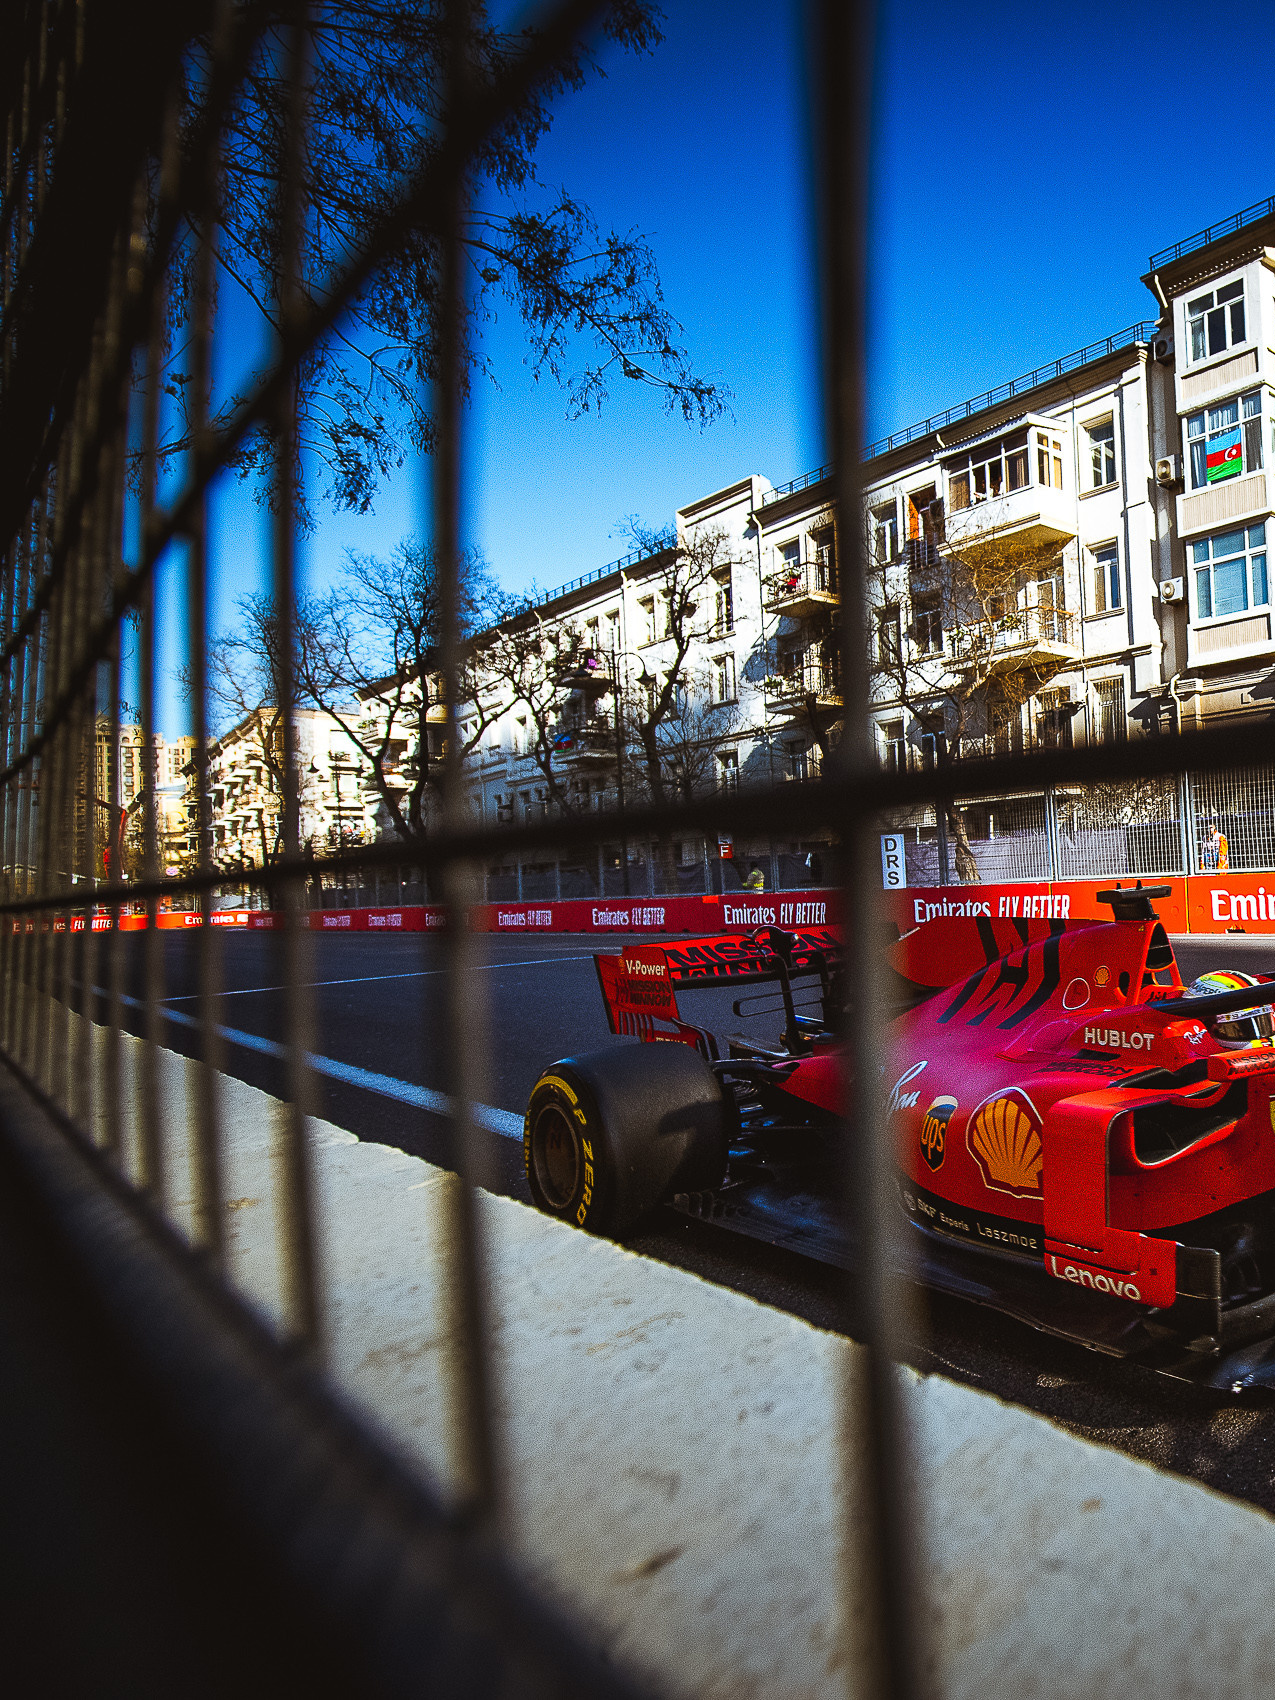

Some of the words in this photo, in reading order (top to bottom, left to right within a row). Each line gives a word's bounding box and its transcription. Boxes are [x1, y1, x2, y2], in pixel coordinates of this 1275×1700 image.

[720, 845, 729, 857] F
[884, 837, 900, 886] DRS
[184, 915, 235, 925] Emrates
[498, 911, 526, 926] Emirates
[592, 908, 630, 926] Emirates
[723, 903, 776, 925] Emirates
[779, 903, 793, 925] FLY
[795, 902, 827, 925] BETTER
[913, 897, 991, 924] Emirates
[91, 919, 114, 930] BETTE
[625, 959, 667, 977] V-Power
[1084, 1027, 1155, 1051] HUBLOT
[920, 1114, 947, 1160] ups
[576, 1137, 594, 1225] ZERO
[917, 1198, 937, 1219] SKF
[1050, 1255, 1142, 1301] Lenovo
